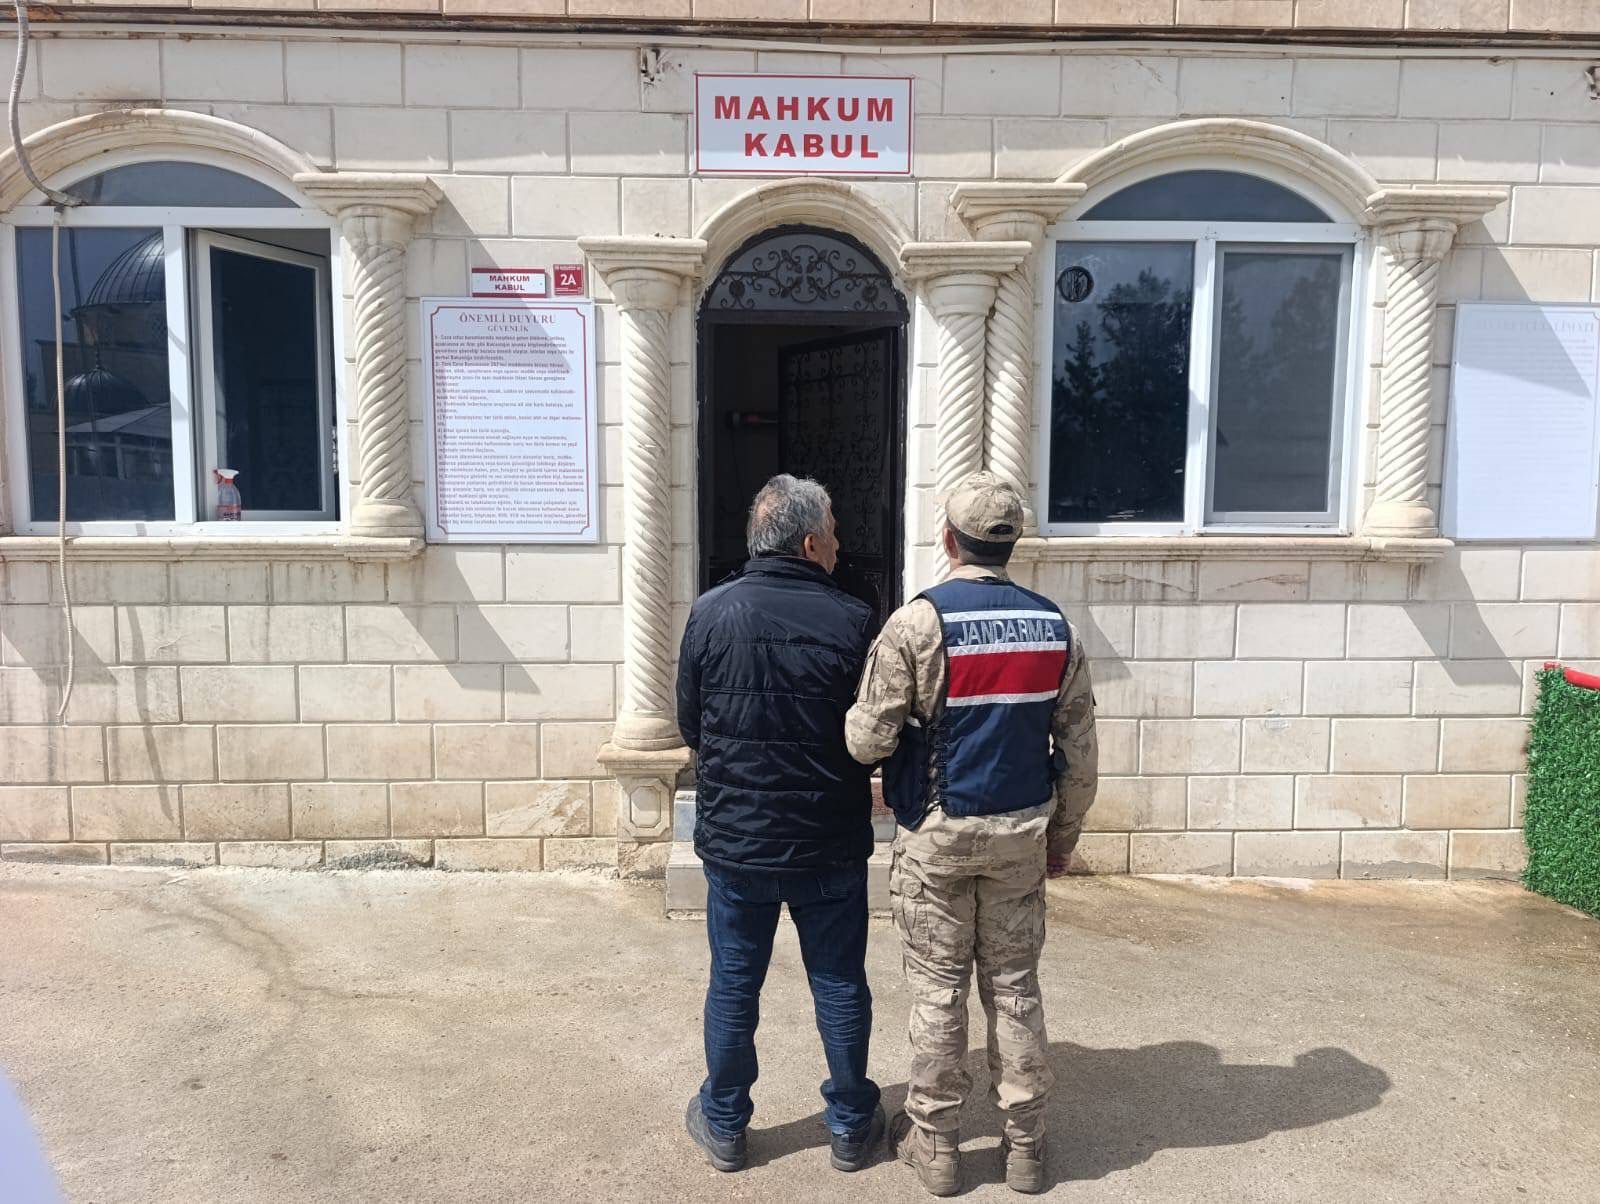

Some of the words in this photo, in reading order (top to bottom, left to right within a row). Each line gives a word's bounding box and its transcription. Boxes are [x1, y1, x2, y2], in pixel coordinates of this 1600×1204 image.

[714, 95, 893, 122] MAHKUM
[744, 133, 879, 159] KABUL
[560, 273, 576, 286] 2A
[459, 311, 505, 323] ÖNEMLİ
[509, 314, 557, 324] DUYURU
[487, 324, 529, 332] GÜVENLİK
[957, 618, 1056, 645] JANDARMA
